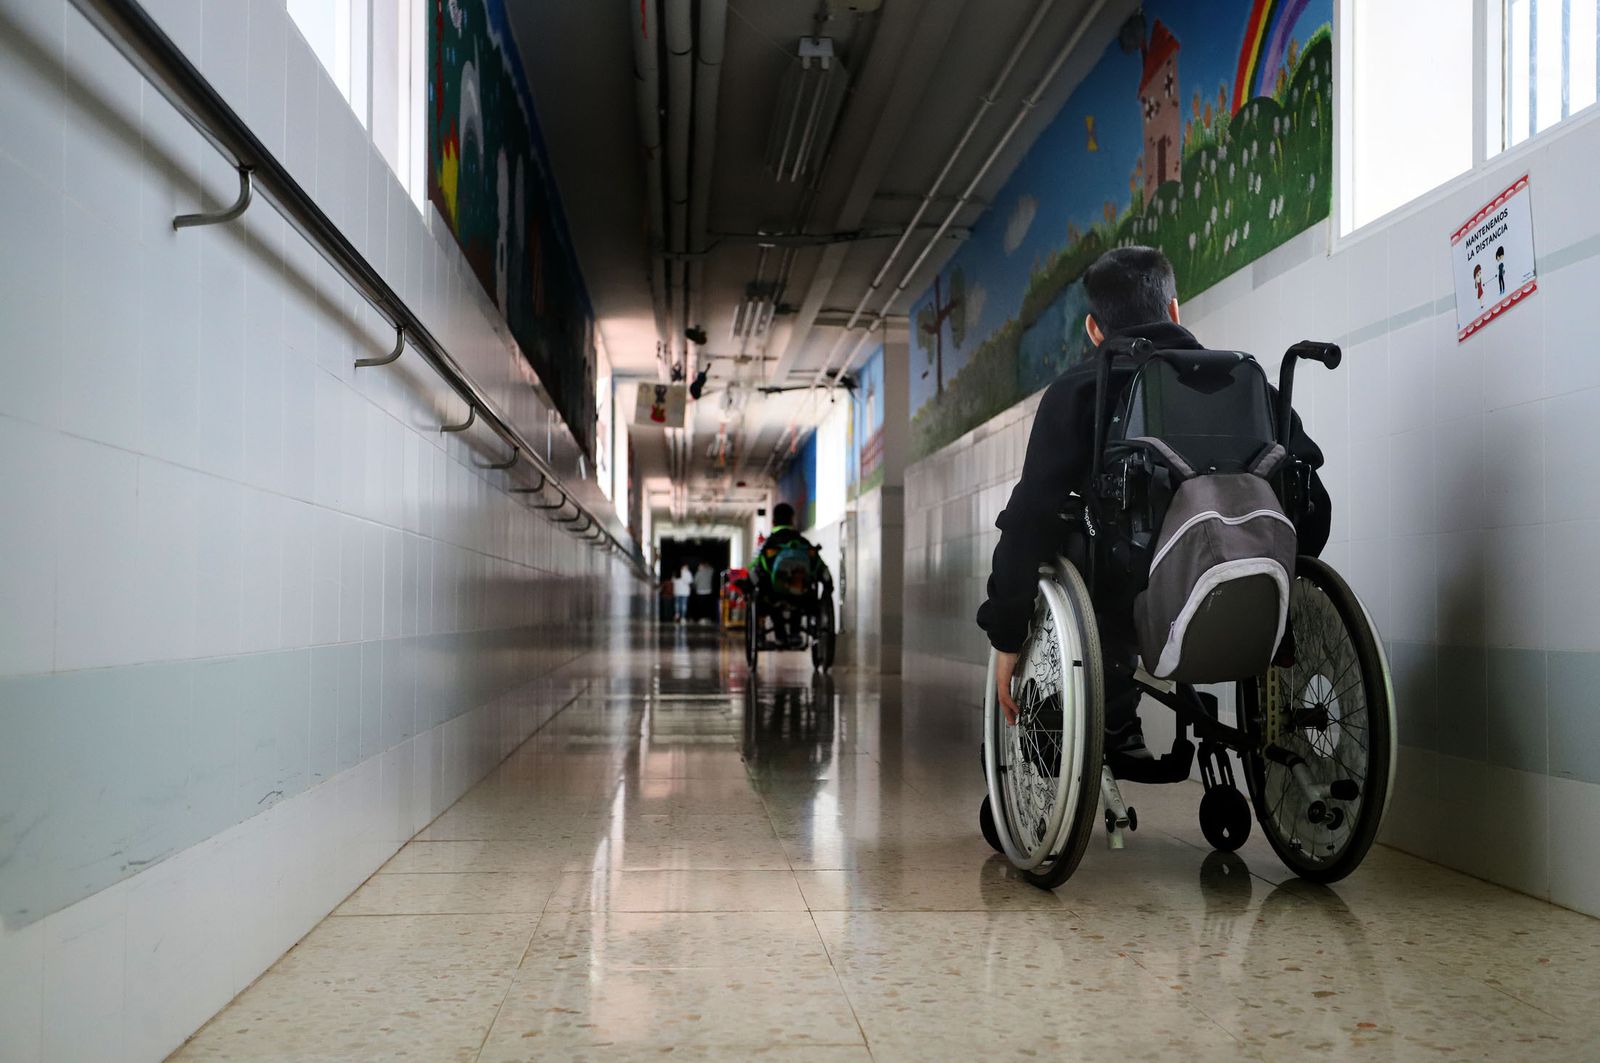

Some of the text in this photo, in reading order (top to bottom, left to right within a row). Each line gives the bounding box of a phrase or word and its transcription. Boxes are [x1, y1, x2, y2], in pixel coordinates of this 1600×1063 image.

[1465, 208, 1508, 249] MANTENEMOS
[1467, 223, 1508, 261] LA DISTANCIA
